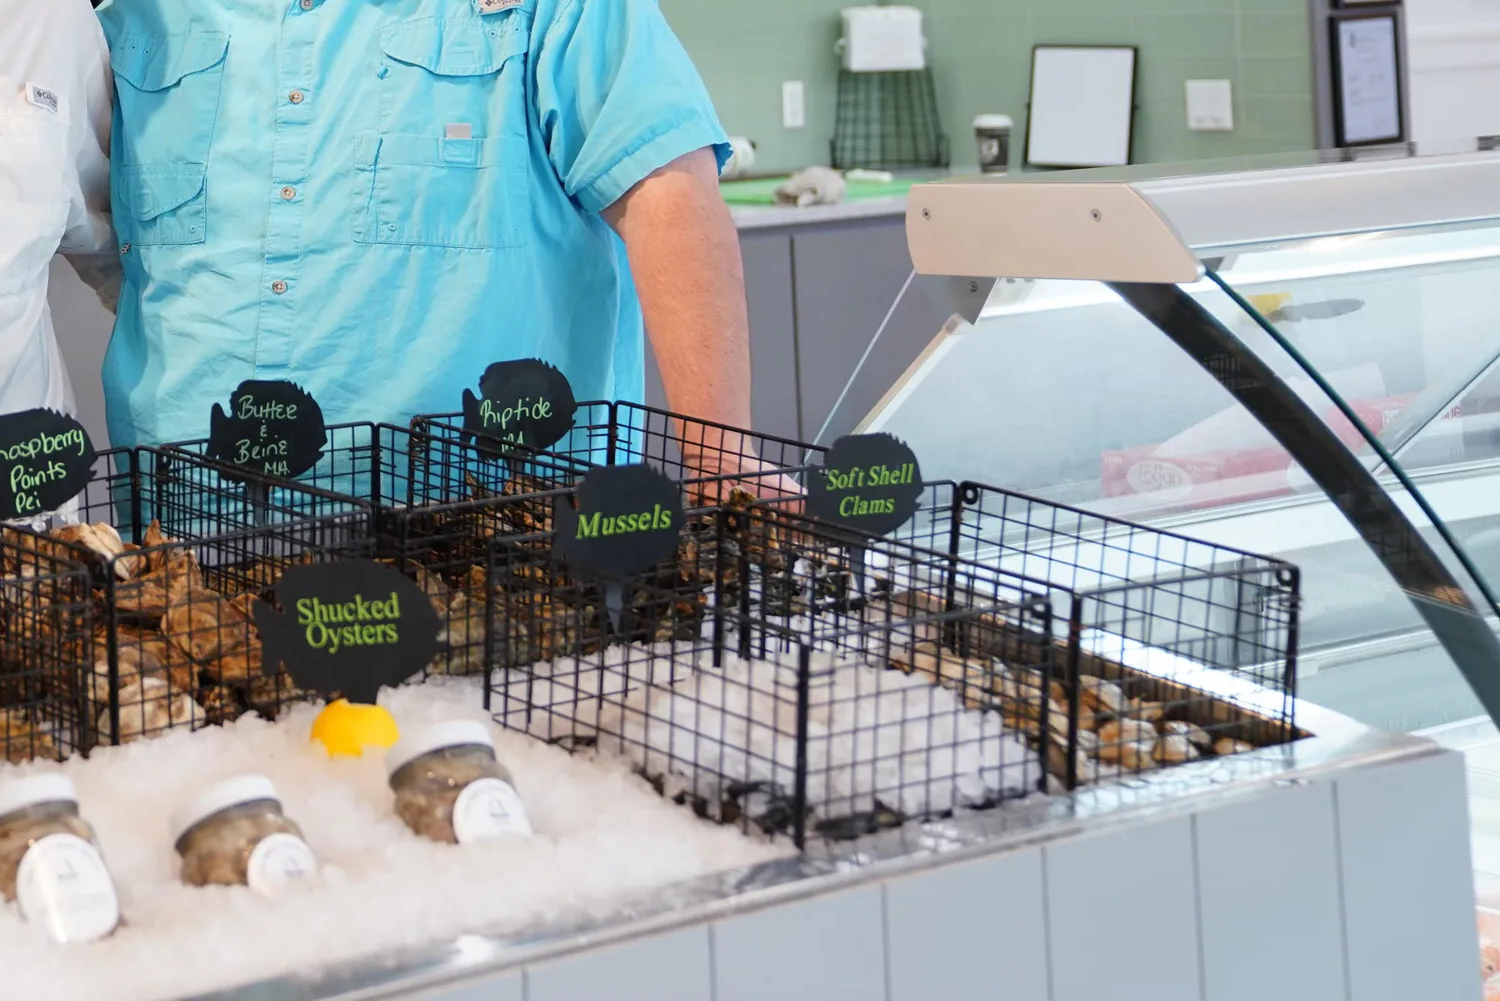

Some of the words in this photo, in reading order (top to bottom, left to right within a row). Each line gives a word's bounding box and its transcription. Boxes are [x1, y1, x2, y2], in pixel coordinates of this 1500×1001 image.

[479, 396, 553, 430] Riptide
[10, 460, 67, 493] Points
[826, 466, 866, 491] Soft
[867, 462, 915, 487] Shell
[575, 503, 673, 540] Mussels
[839, 495, 896, 518] Clams
[296, 591, 401, 625] Shucked
[305, 621, 399, 655] Oysters
